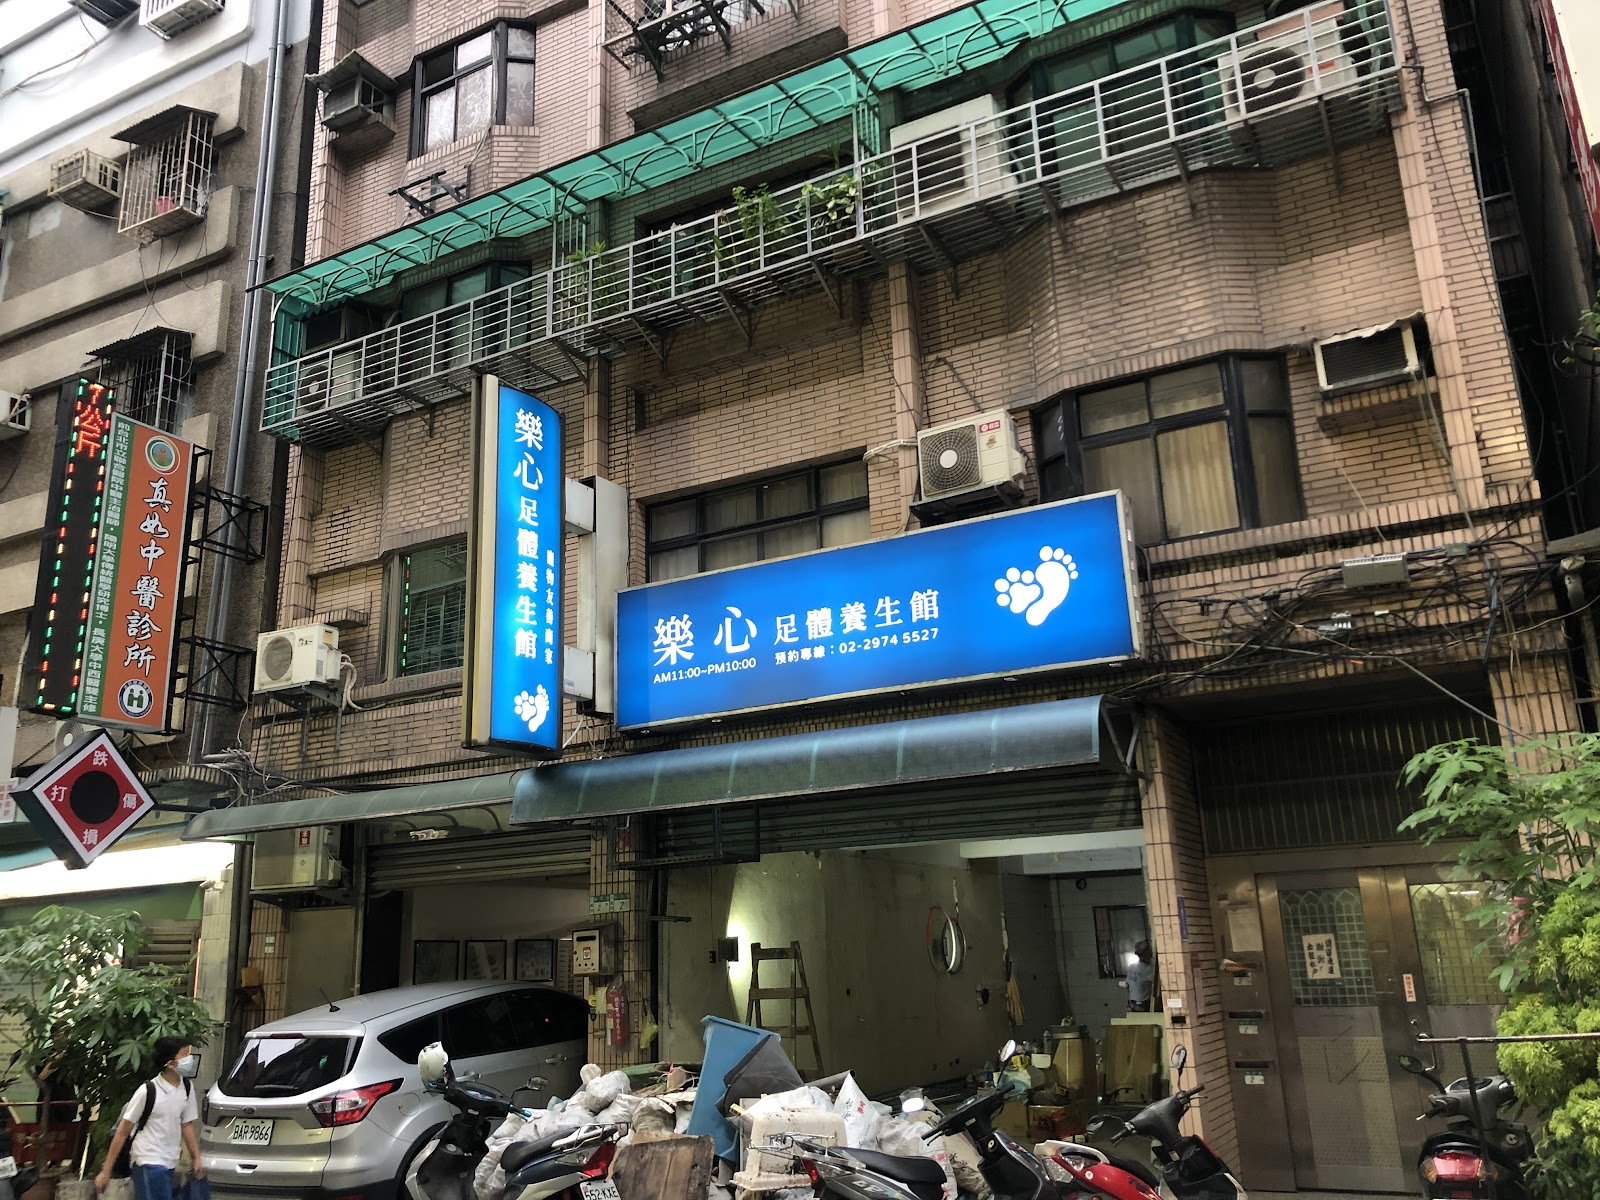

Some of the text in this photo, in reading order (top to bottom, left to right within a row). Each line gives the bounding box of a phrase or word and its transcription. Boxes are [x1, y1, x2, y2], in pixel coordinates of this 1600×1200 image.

[122, 476, 173, 678] 真如中醫診所
[513, 407, 543, 660] 樂心足體養生館
[902, 627, 939, 644] 5527
